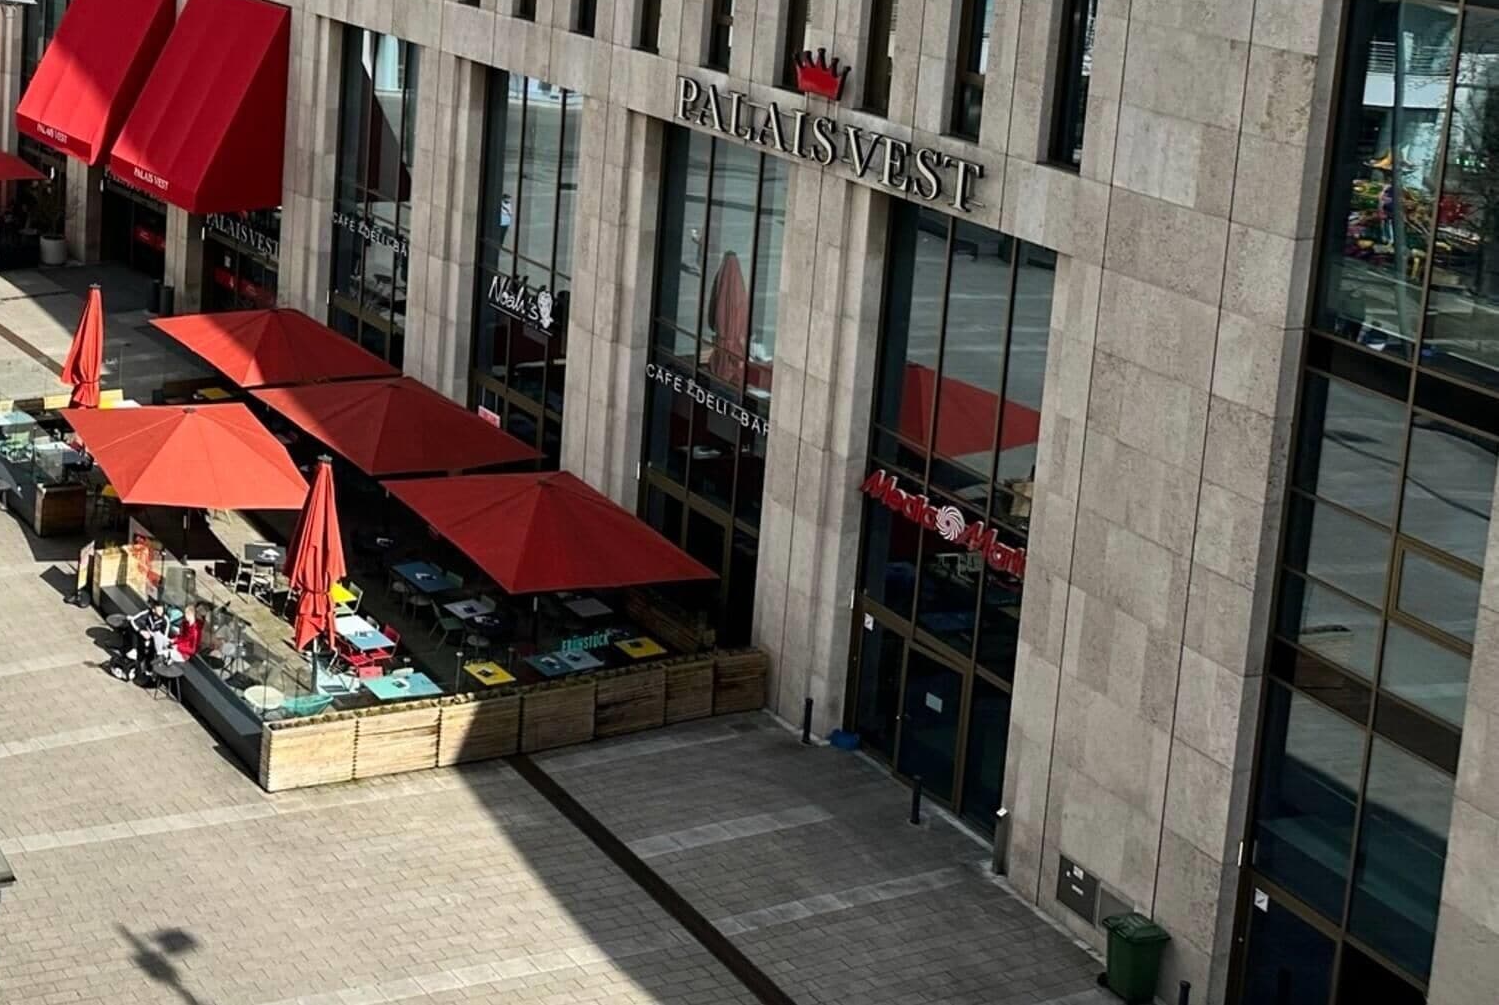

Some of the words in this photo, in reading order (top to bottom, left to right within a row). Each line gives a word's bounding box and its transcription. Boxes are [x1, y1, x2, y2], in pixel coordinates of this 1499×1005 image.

[676, 74, 838, 166] PALAIS
[843, 123, 985, 213] VEST
[206, 212, 248, 244] PALAIS
[249, 228, 279, 259] VEST
[488, 275, 539, 321] Noah's
[695, 388, 727, 416] DELI
[860, 469, 940, 532] Media
